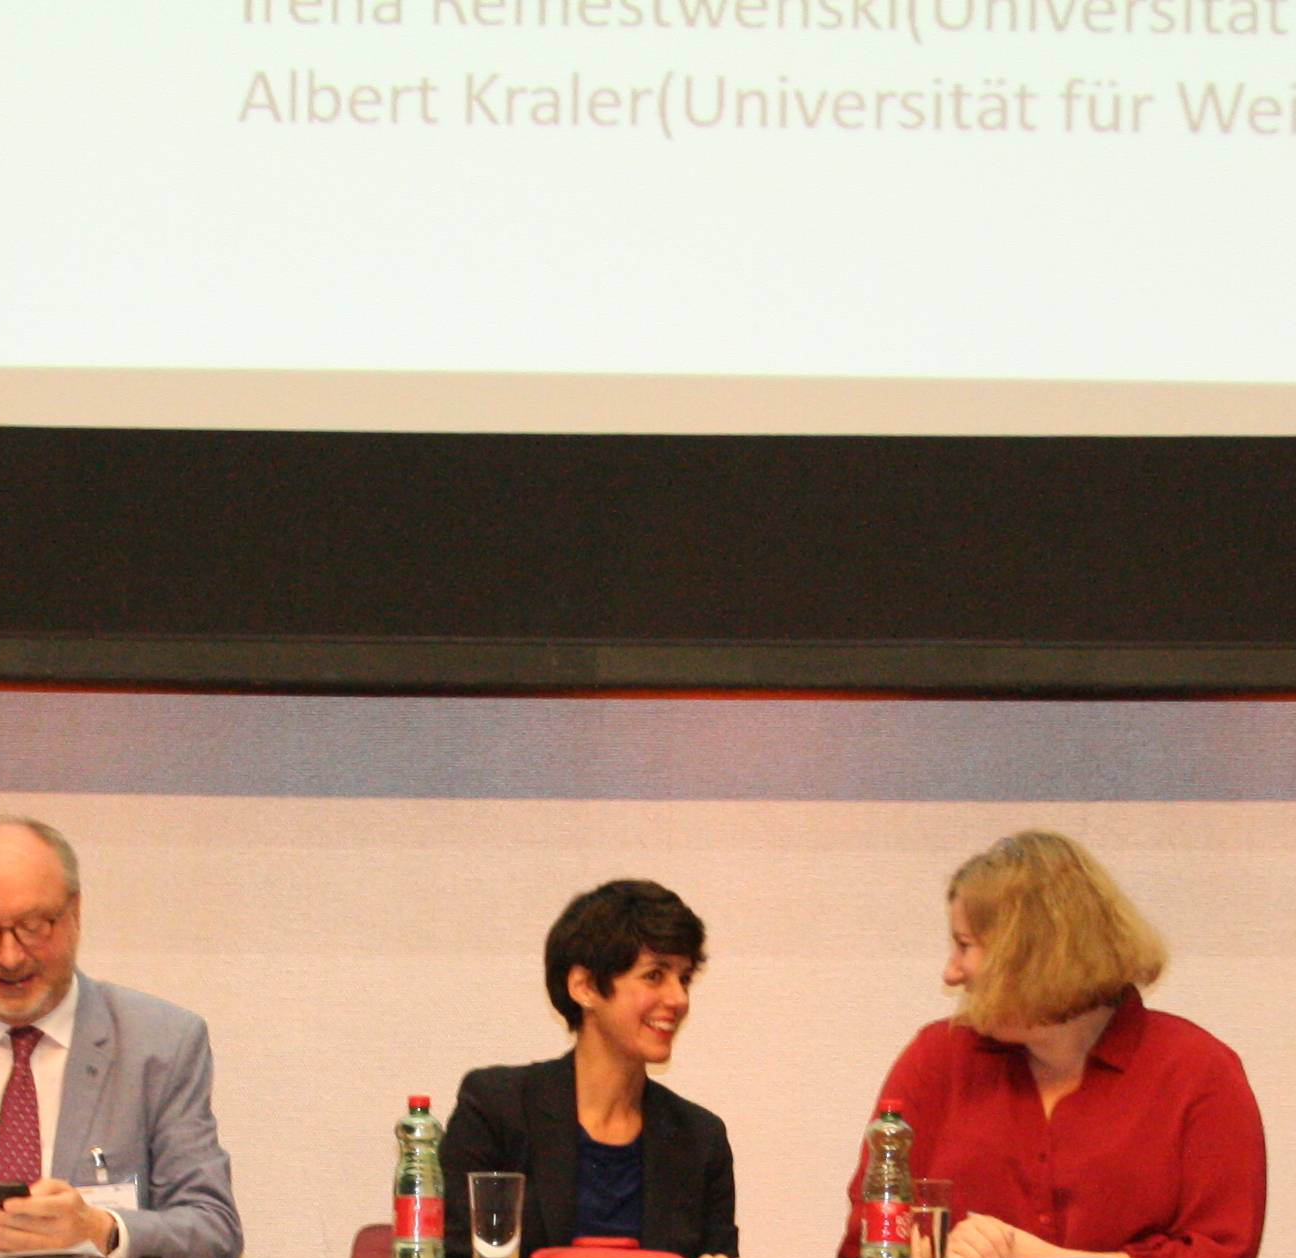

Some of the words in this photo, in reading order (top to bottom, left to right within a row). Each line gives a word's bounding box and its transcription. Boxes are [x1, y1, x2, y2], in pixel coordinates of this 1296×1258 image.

[236, 69, 441, 127] Albert
[464, 71, 1040, 142] Kraler(Universität
[1058, 77, 1157, 135] für
